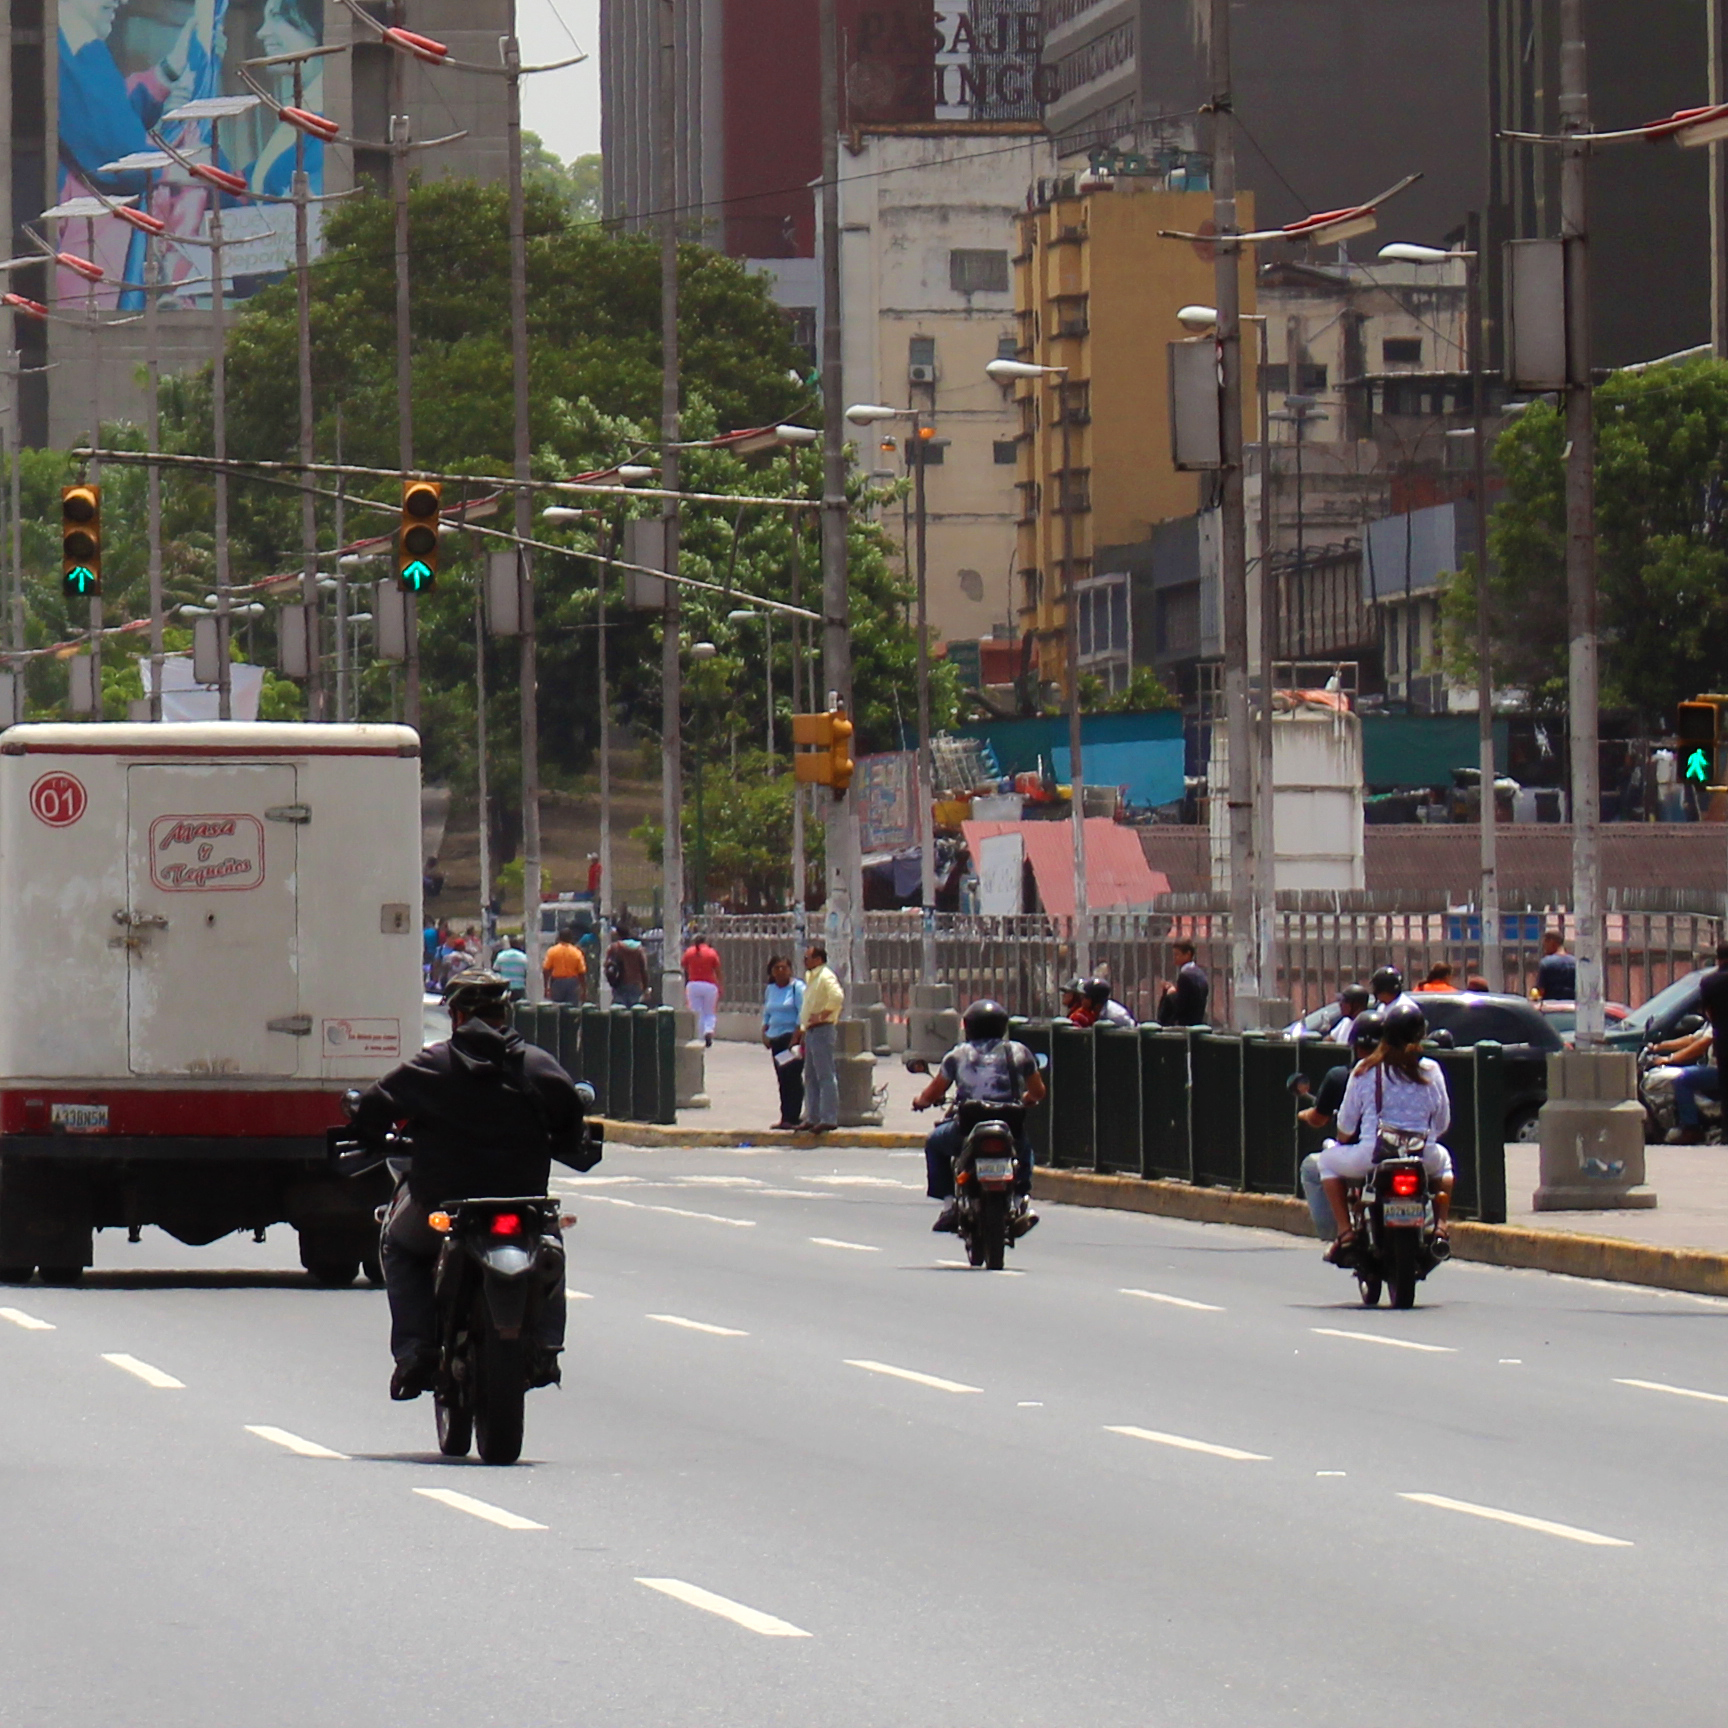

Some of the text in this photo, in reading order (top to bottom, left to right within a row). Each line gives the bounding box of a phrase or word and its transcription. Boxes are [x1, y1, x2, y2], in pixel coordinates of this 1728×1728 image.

[856, 10, 1044, 54] PASAJE
[1089, 146, 1213, 178] HOTE
[40, 787, 74, 818] 01
[159, 820, 237, 850] Masa
[197, 842, 214, 861] y
[160, 857, 252, 887] Tequeños
